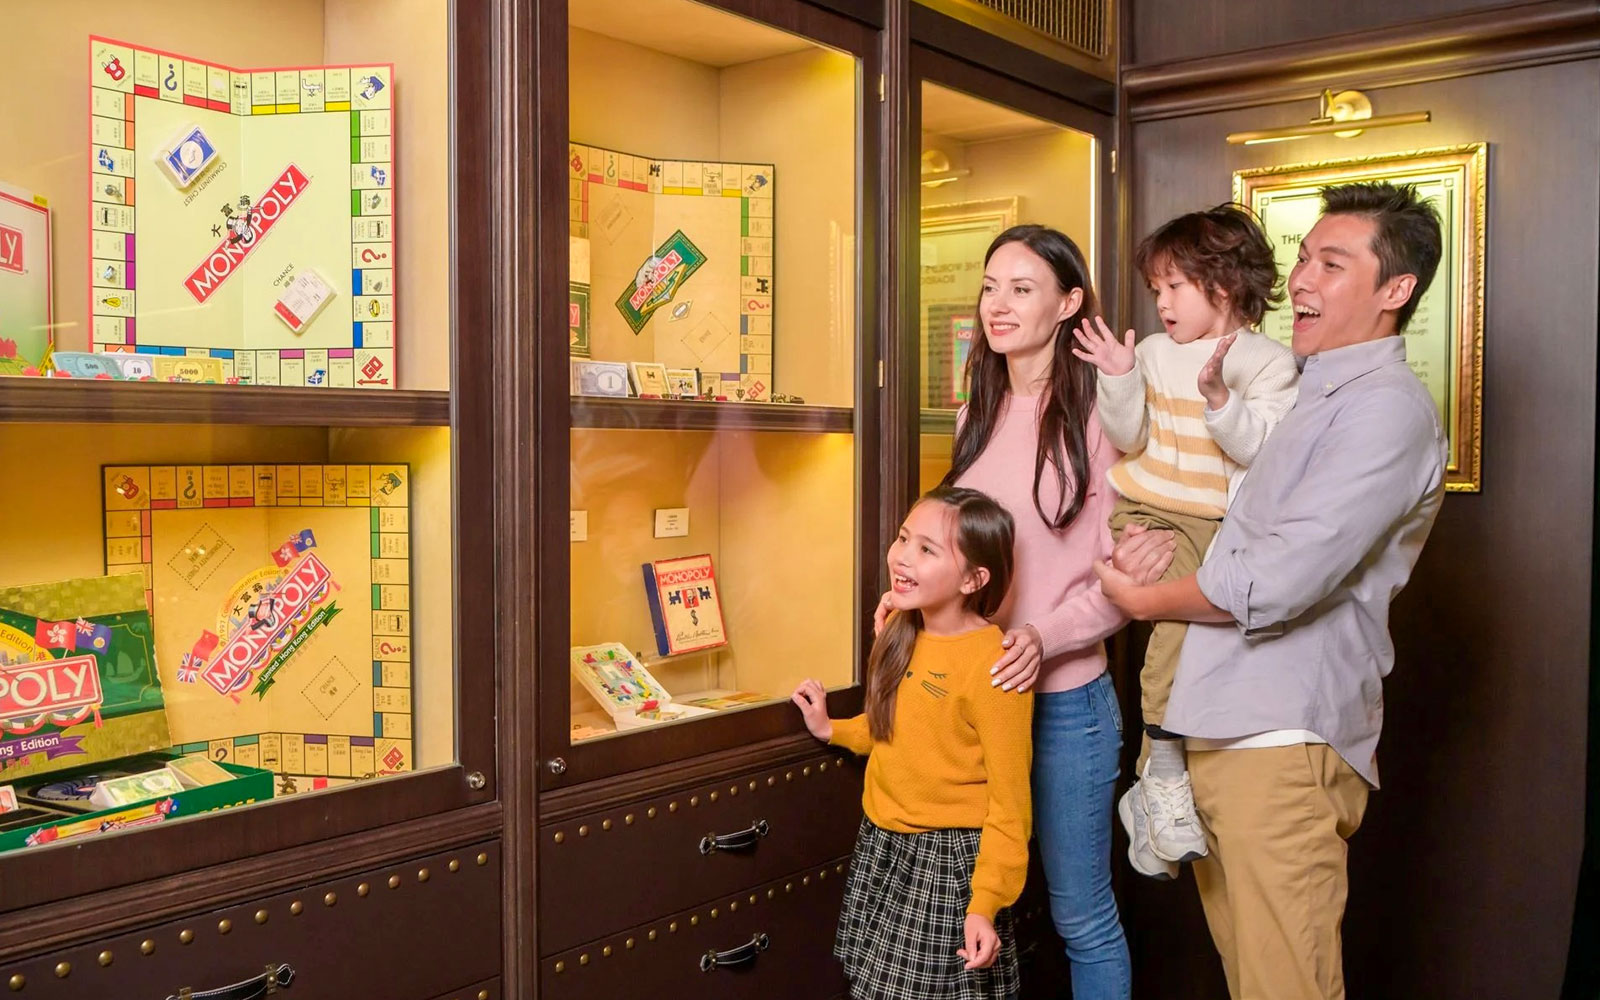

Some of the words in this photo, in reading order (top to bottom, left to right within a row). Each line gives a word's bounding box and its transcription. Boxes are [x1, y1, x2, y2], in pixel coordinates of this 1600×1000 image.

[198, 161, 227, 191] COMMUNITY
[184, 189, 199, 207] CHEST
[191, 171, 298, 298] MONOPOLY
[1281, 233, 1302, 245] THE
[273, 262, 295, 287] CHANCE
[84, 362, 99, 370] 500
[179, 368, 199, 376] 5000
[659, 568, 711, 584] MONOPOLY
[210, 558, 320, 689] MONOPOLY
[0, 630, 34, 655] Edition
[260, 661, 279, 682] Limited
[279, 645, 296, 661] Hong
[293, 631, 308, 647] Kong
[307, 610, 326, 631] Edition
[20, 735, 60, 751] Edition
